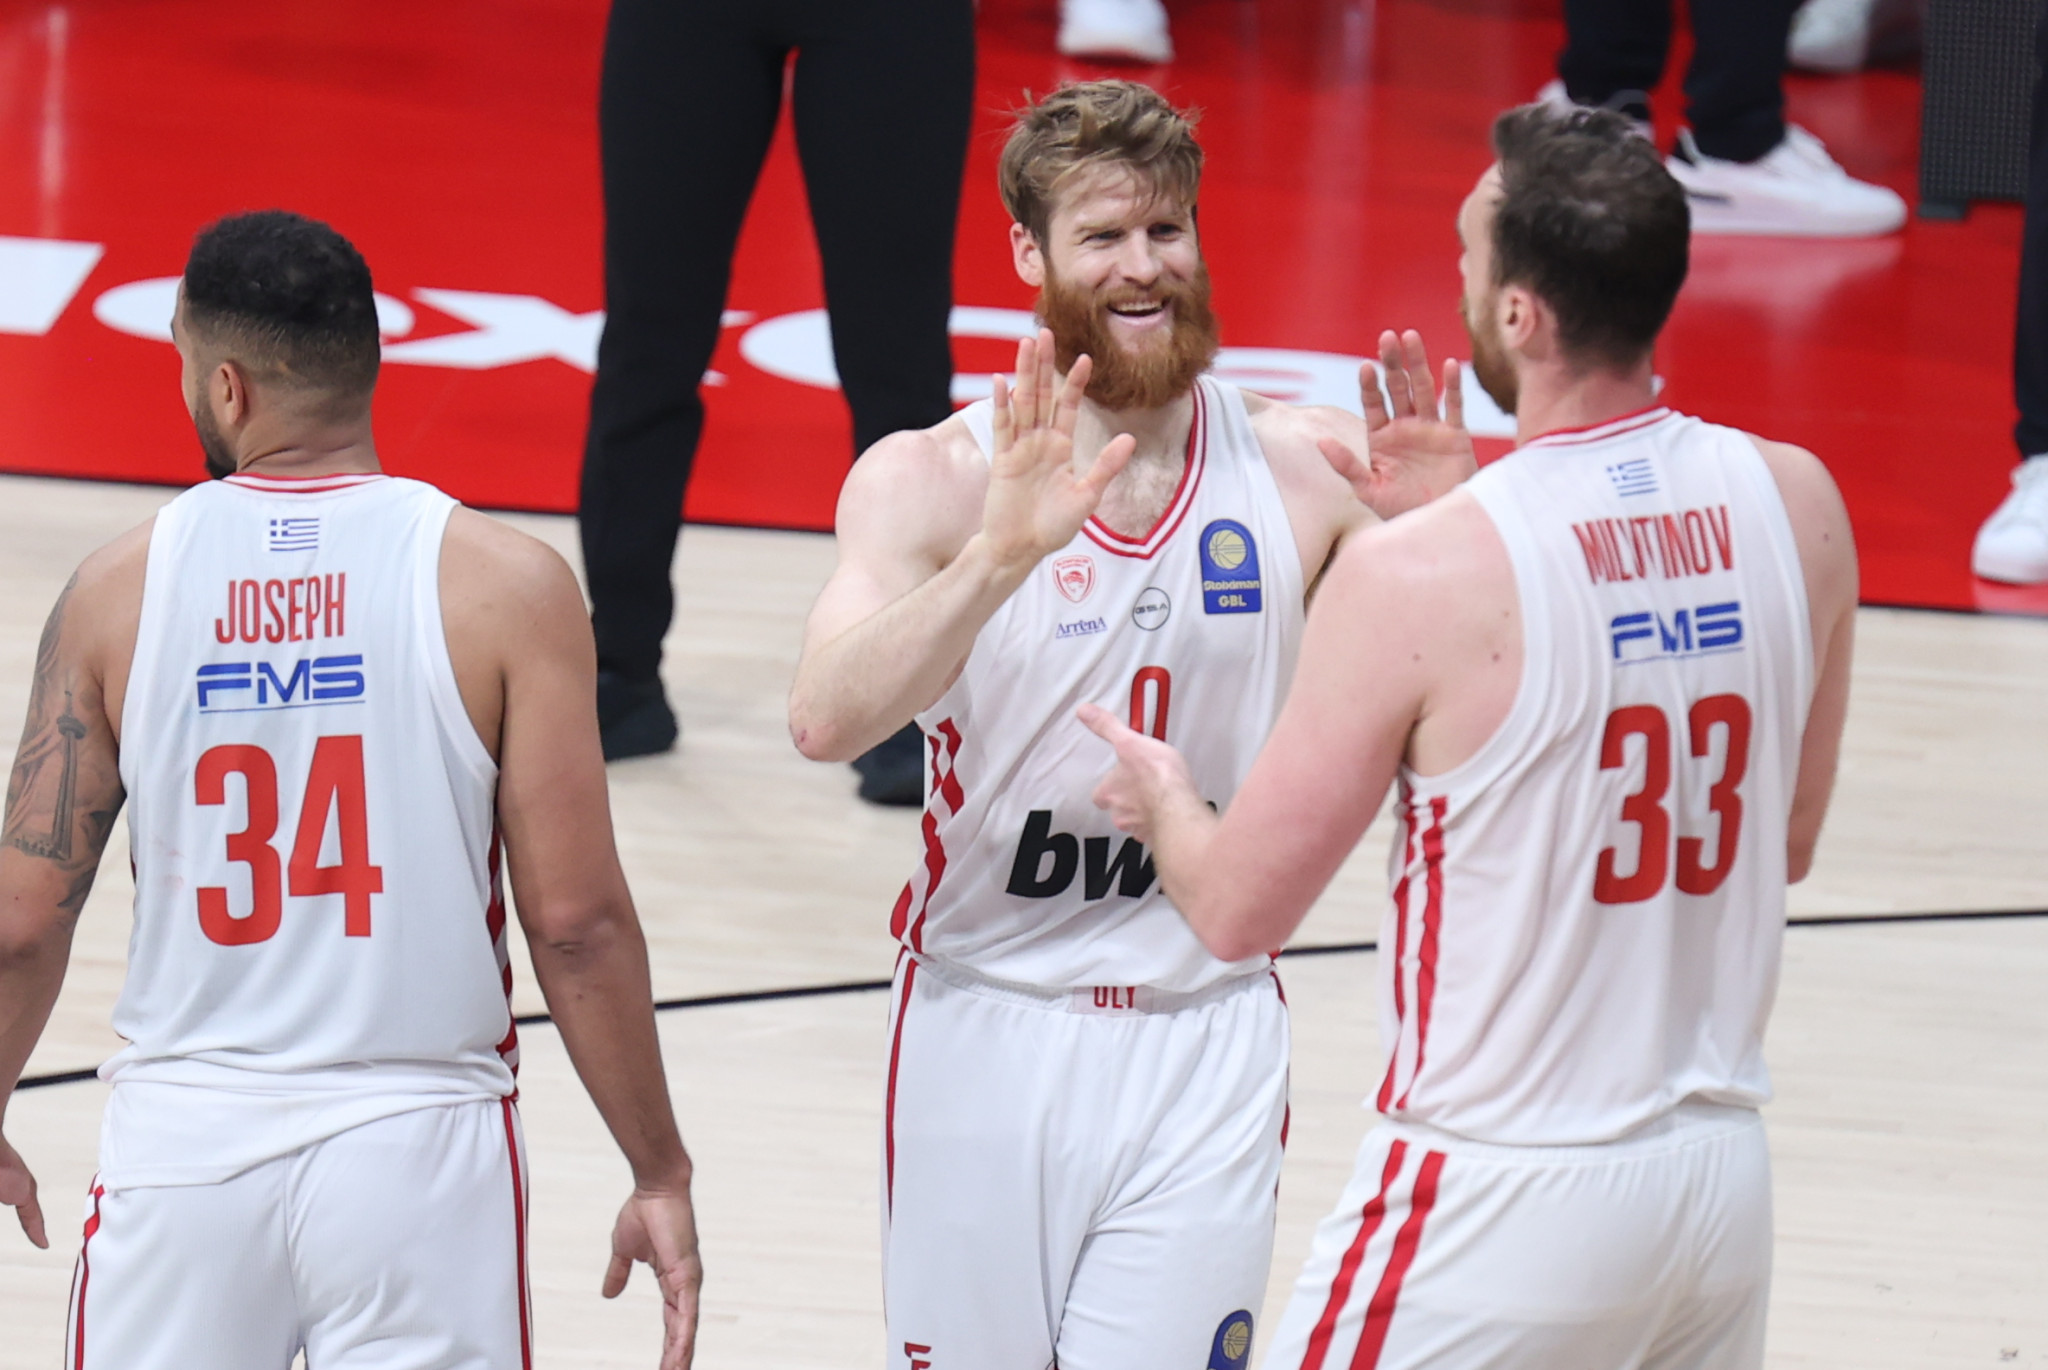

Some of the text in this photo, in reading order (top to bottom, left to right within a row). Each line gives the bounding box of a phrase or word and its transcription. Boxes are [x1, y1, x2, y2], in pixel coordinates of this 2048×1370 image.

[214, 571, 346, 644] JOSEPH
[1218, 594, 1247, 608] GBL
[1611, 600, 1743, 659] FMS
[196, 653, 365, 708] FMS
[1129, 665, 1172, 743] 0
[1593, 691, 1753, 905] 33
[194, 734, 384, 946] 34
[1005, 801, 1217, 901] bw
